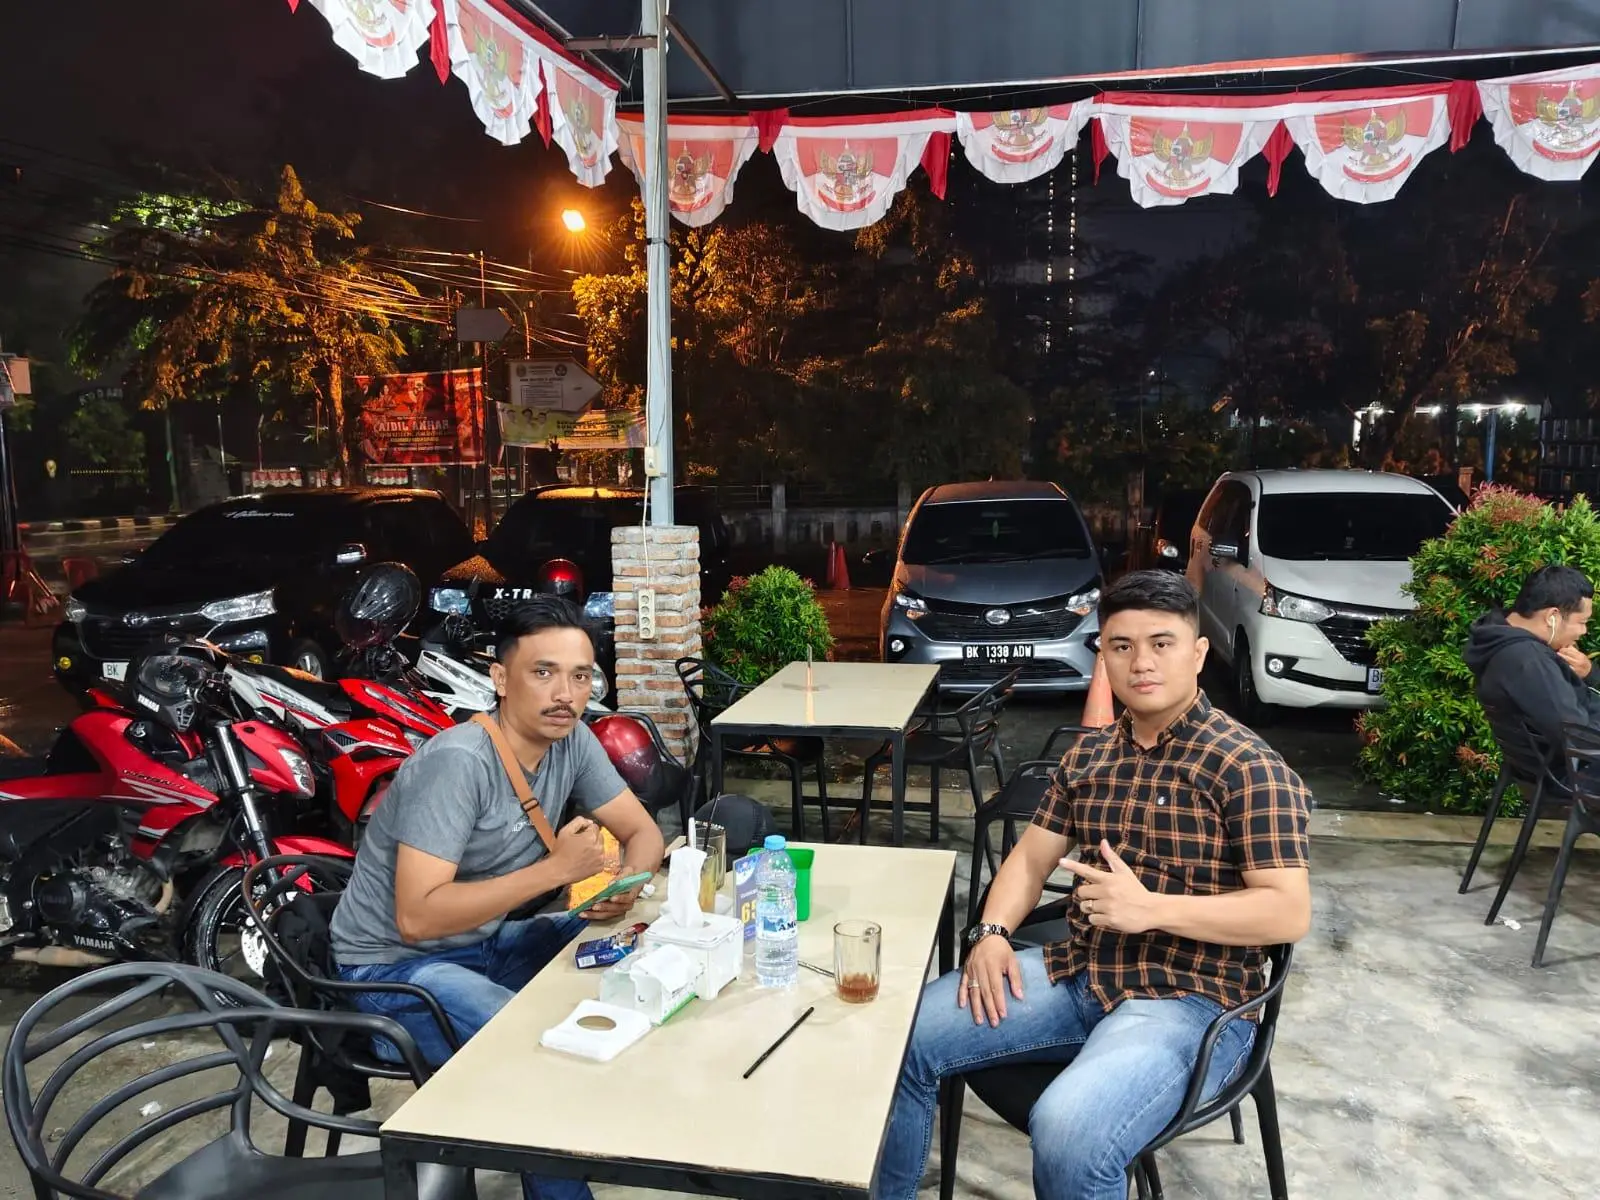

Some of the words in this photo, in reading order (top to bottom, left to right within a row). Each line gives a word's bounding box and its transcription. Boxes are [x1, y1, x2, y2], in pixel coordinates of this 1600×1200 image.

[966, 646, 979, 659] BK
[106, 664, 120, 677] BK
[367, 723, 397, 739] HONDA
[73, 934, 116, 951] YAMAHA
